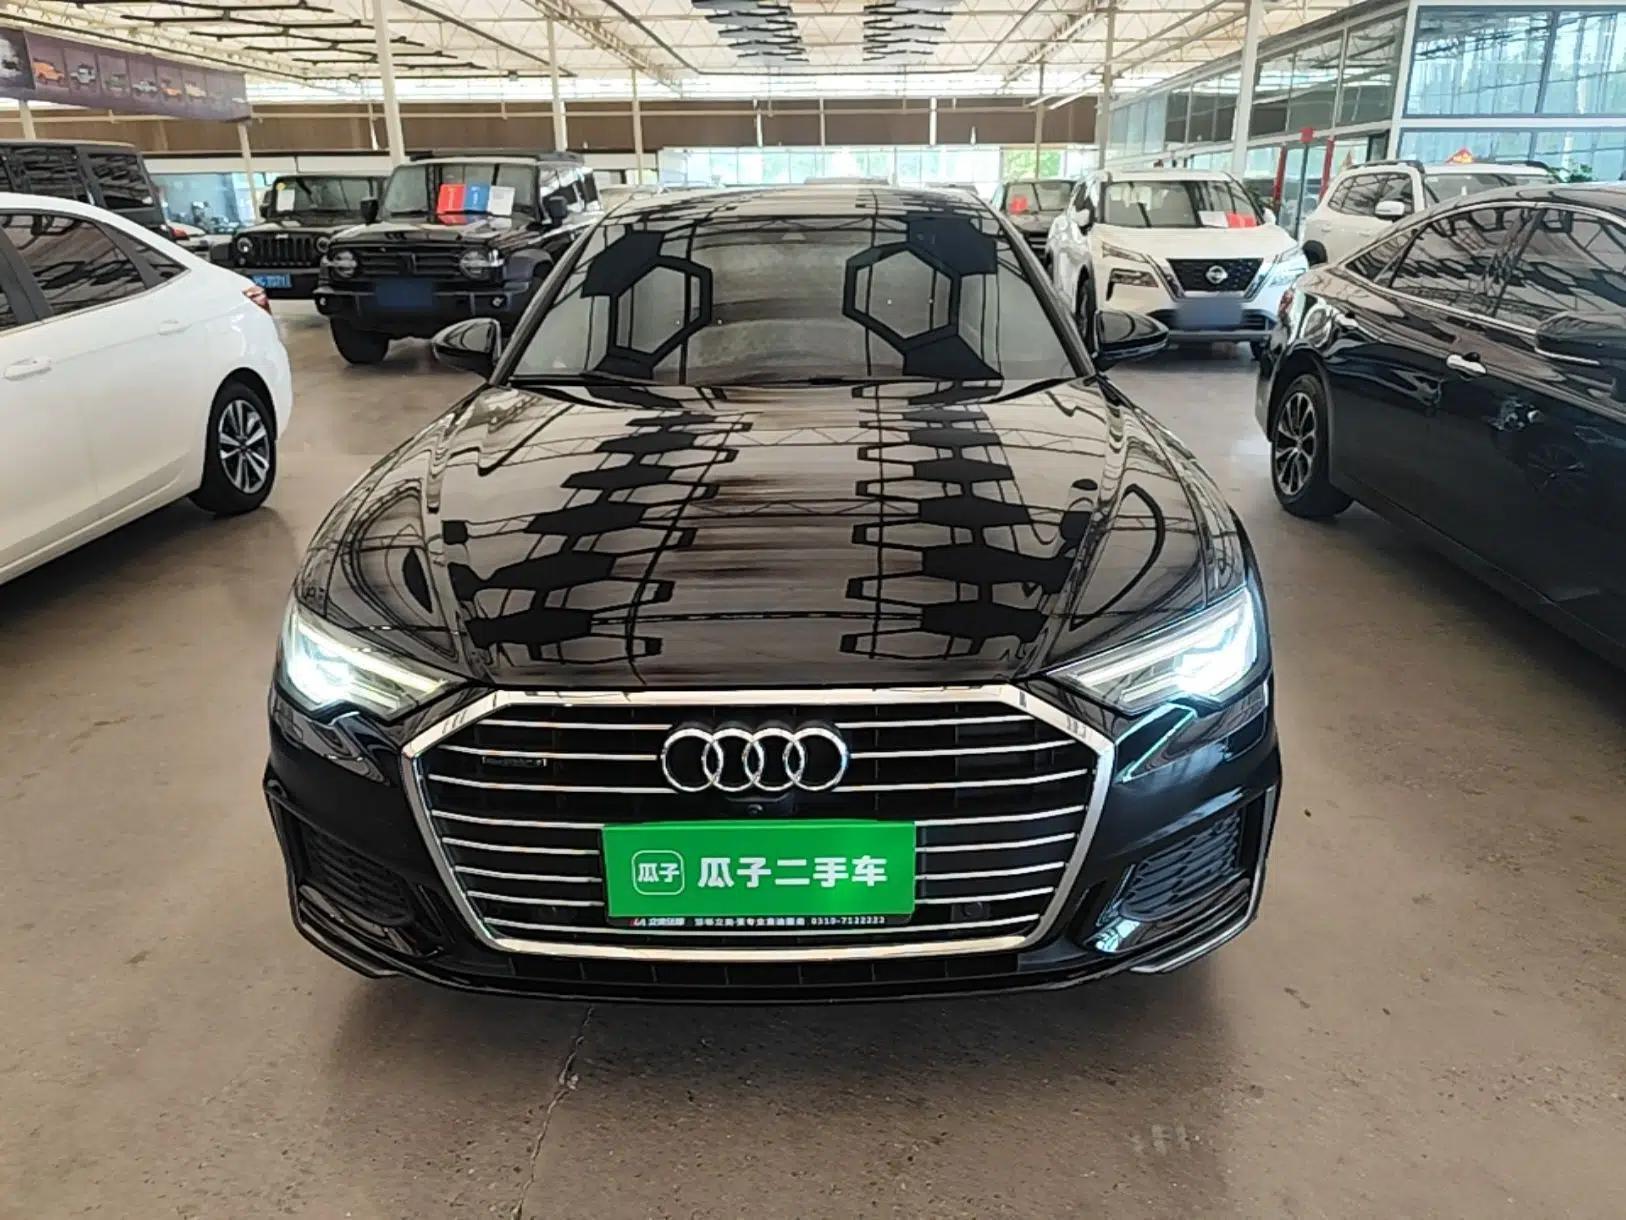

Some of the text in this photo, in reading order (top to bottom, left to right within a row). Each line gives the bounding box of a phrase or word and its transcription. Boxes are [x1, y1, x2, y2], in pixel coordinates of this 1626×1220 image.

[637, 862, 680, 883] 瓜子
[697, 855, 888, 888] 瓜子二手车
